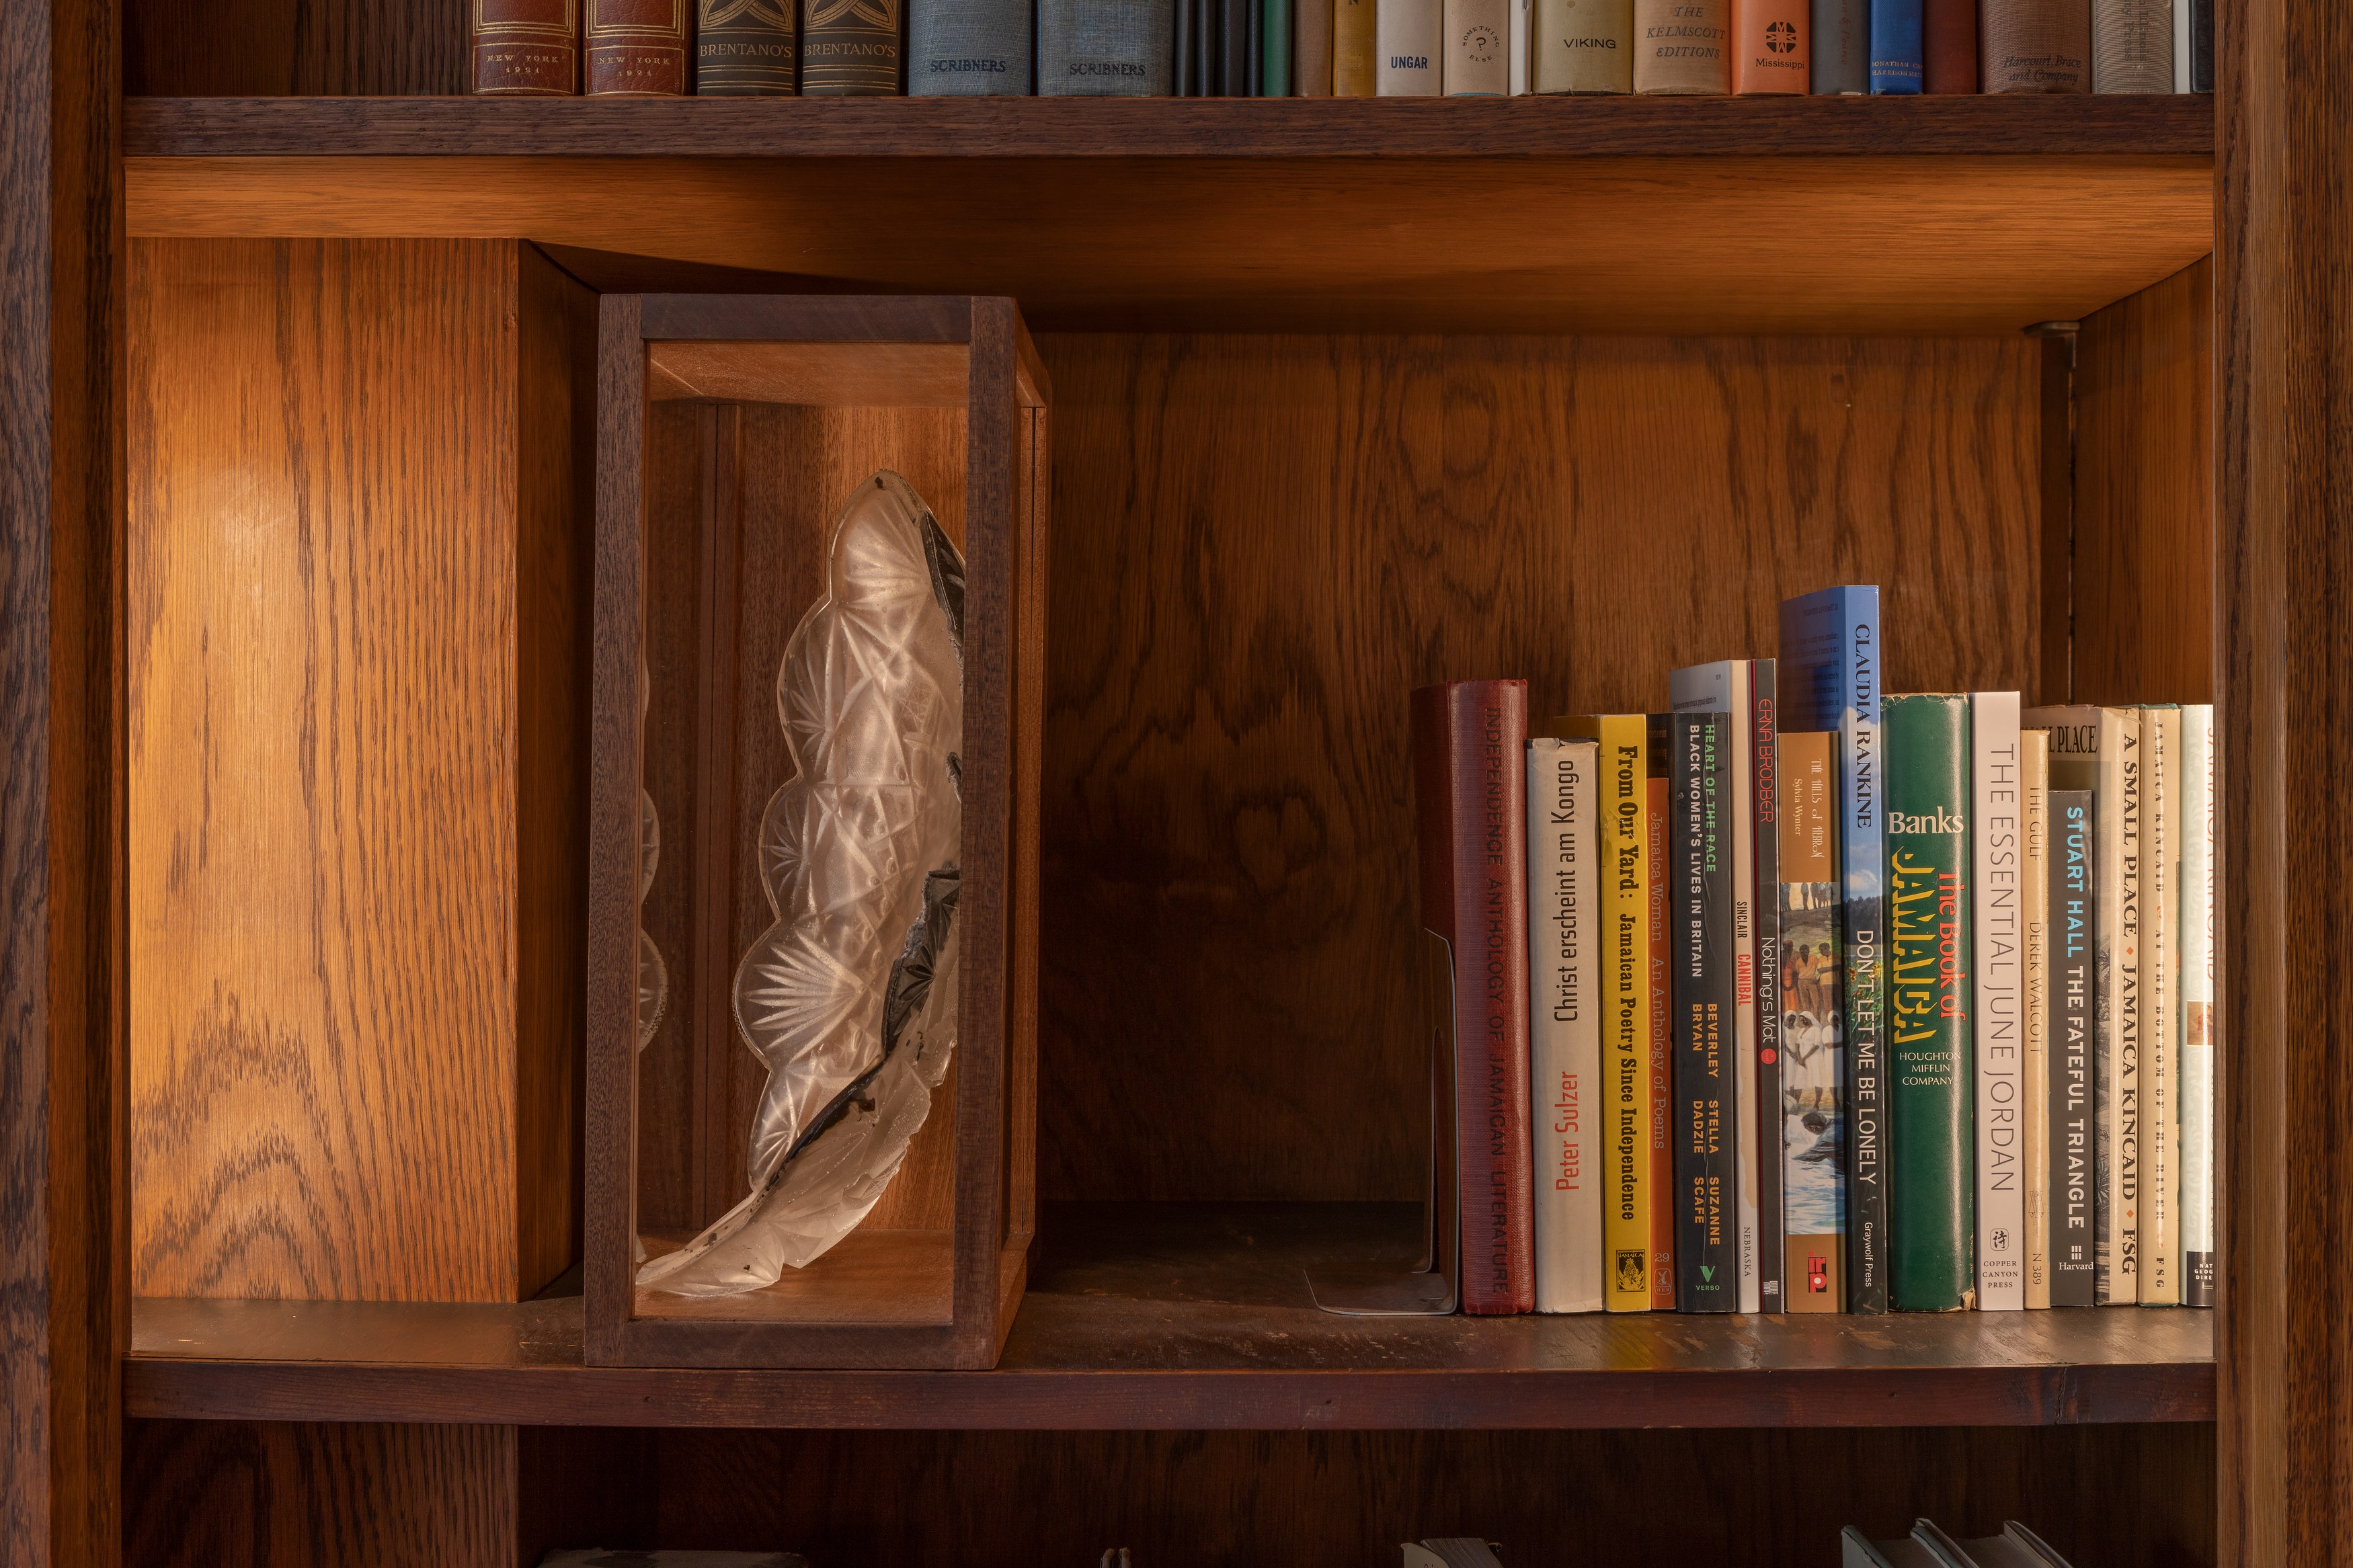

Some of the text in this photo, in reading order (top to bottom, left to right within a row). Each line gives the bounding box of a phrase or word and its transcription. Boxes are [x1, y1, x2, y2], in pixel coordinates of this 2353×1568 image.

[1462, 26, 1500, 48] SOMETHING
[1646, 26, 1726, 40] KELMSCOTT
[1674, 7, 1704, 17] THE
[2140, 11, 2149, 61] Illinois
[486, 54, 515, 63] NEW
[597, 56, 671, 65] NEW YORK
[700, 43, 793, 58] BRENTANO'S
[805, 42, 896, 57] BRENTANO'S
[930, 59, 1006, 73] SCRIBNERS
[1390, 56, 1428, 69] UNGAR
[1469, 54, 1493, 63] ELSE
[1563, 38, 1616, 49] VIKING
[1656, 47, 1721, 59] EDITIONS
[1755, 58, 1805, 70] Mississippi
[2057, 54, 2081, 68] Brace
[2125, 22, 2135, 61] Press
[1070, 63, 1146, 76] SCRIBNERS
[2009, 69, 2079, 85] and Company
[1856, 624, 1872, 829] CLAUDIA RANKINE
[2057, 725, 2098, 754] PLACE
[1618, 746, 1638, 798] From
[1759, 699, 1773, 822] ERNA BRODBER
[1811, 758, 1823, 774] THE
[1705, 725, 1716, 872] HEART OF THE RACE
[1792, 778, 1803, 836] Sylvia Wynter
[1811, 780, 1824, 803] HILLS
[2155, 722, 2164, 893] JAMAICA KINCAID
[1618, 802, 1638, 839] Our
[1888, 806, 1964, 834] Banks
[2029, 784, 2042, 861] THE GULF
[2123, 734, 2137, 938] A SMALL PLACE
[1689, 725, 1702, 977] BLACK WOMEN'S LIVES IN BRITAIN
[1551, 759, 1579, 1022] Christ erscheint am Kongo
[1650, 812, 1663, 942] Jamaica Woman
[2067, 807, 2083, 958] STUART HALL
[1737, 901, 1748, 938] SINCLAIR
[1892, 845, 1937, 1044] JAMAICA
[1620, 913, 1636, 992] Jamaican
[1939, 872, 1966, 1021] The Book of
[1983, 743, 2015, 1190] THE ESSENTIAL JUNE JORDAN
[1486, 707, 1508, 1292] INDEPENDENCE ANTHOLOGY OF JAMAICAN LITERATURE
[1738, 954, 1752, 1007] CANNIBAL
[1759, 937, 1776, 1043] Nothing's Mat
[2030, 921, 2042, 1055] DEREK WALCOTT
[1618, 997, 1637, 1053] Poetry
[1692, 1003, 1703, 1051] BRYAN
[1708, 1003, 1718, 1078] BEVERLEY
[1651, 955, 1667, 1149] An Anthology of Poems
[1857, 930, 1876, 1185] DON'T LET ME BE LONELY
[1899, 1053, 1961, 1061] HOUGHTON
[1911, 1064, 1950, 1073] MIFFLIN
[2155, 930, 2165, 1221] AT THE BOTTOM OF THE RIVER
[1621, 1058, 1638, 1103] Since
[1902, 1077, 1953, 1085] COMPANY
[2068, 966, 2085, 1229] THE FATEFUL TRIANGLE
[2122, 964, 2137, 1200] JAMAICA KINCAID
[1554, 1071, 1579, 1190] Peter Sulzer
[1693, 1101, 1704, 1154] DADZIE
[1708, 1100, 1719, 1154] STELLA
[1618, 1109, 1637, 1221] Independence
[1694, 1177, 1705, 1224] SCAFE
[1709, 1177, 1720, 1245] SUZANNE
[1654, 1253, 1670, 1262] 29
[1863, 1222, 1874, 1287] Graywolf Press
[2032, 1253, 2042, 1285] N 389
[2121, 1228, 2136, 1275] FSG
[2156, 1257, 2165, 1288] FSG
